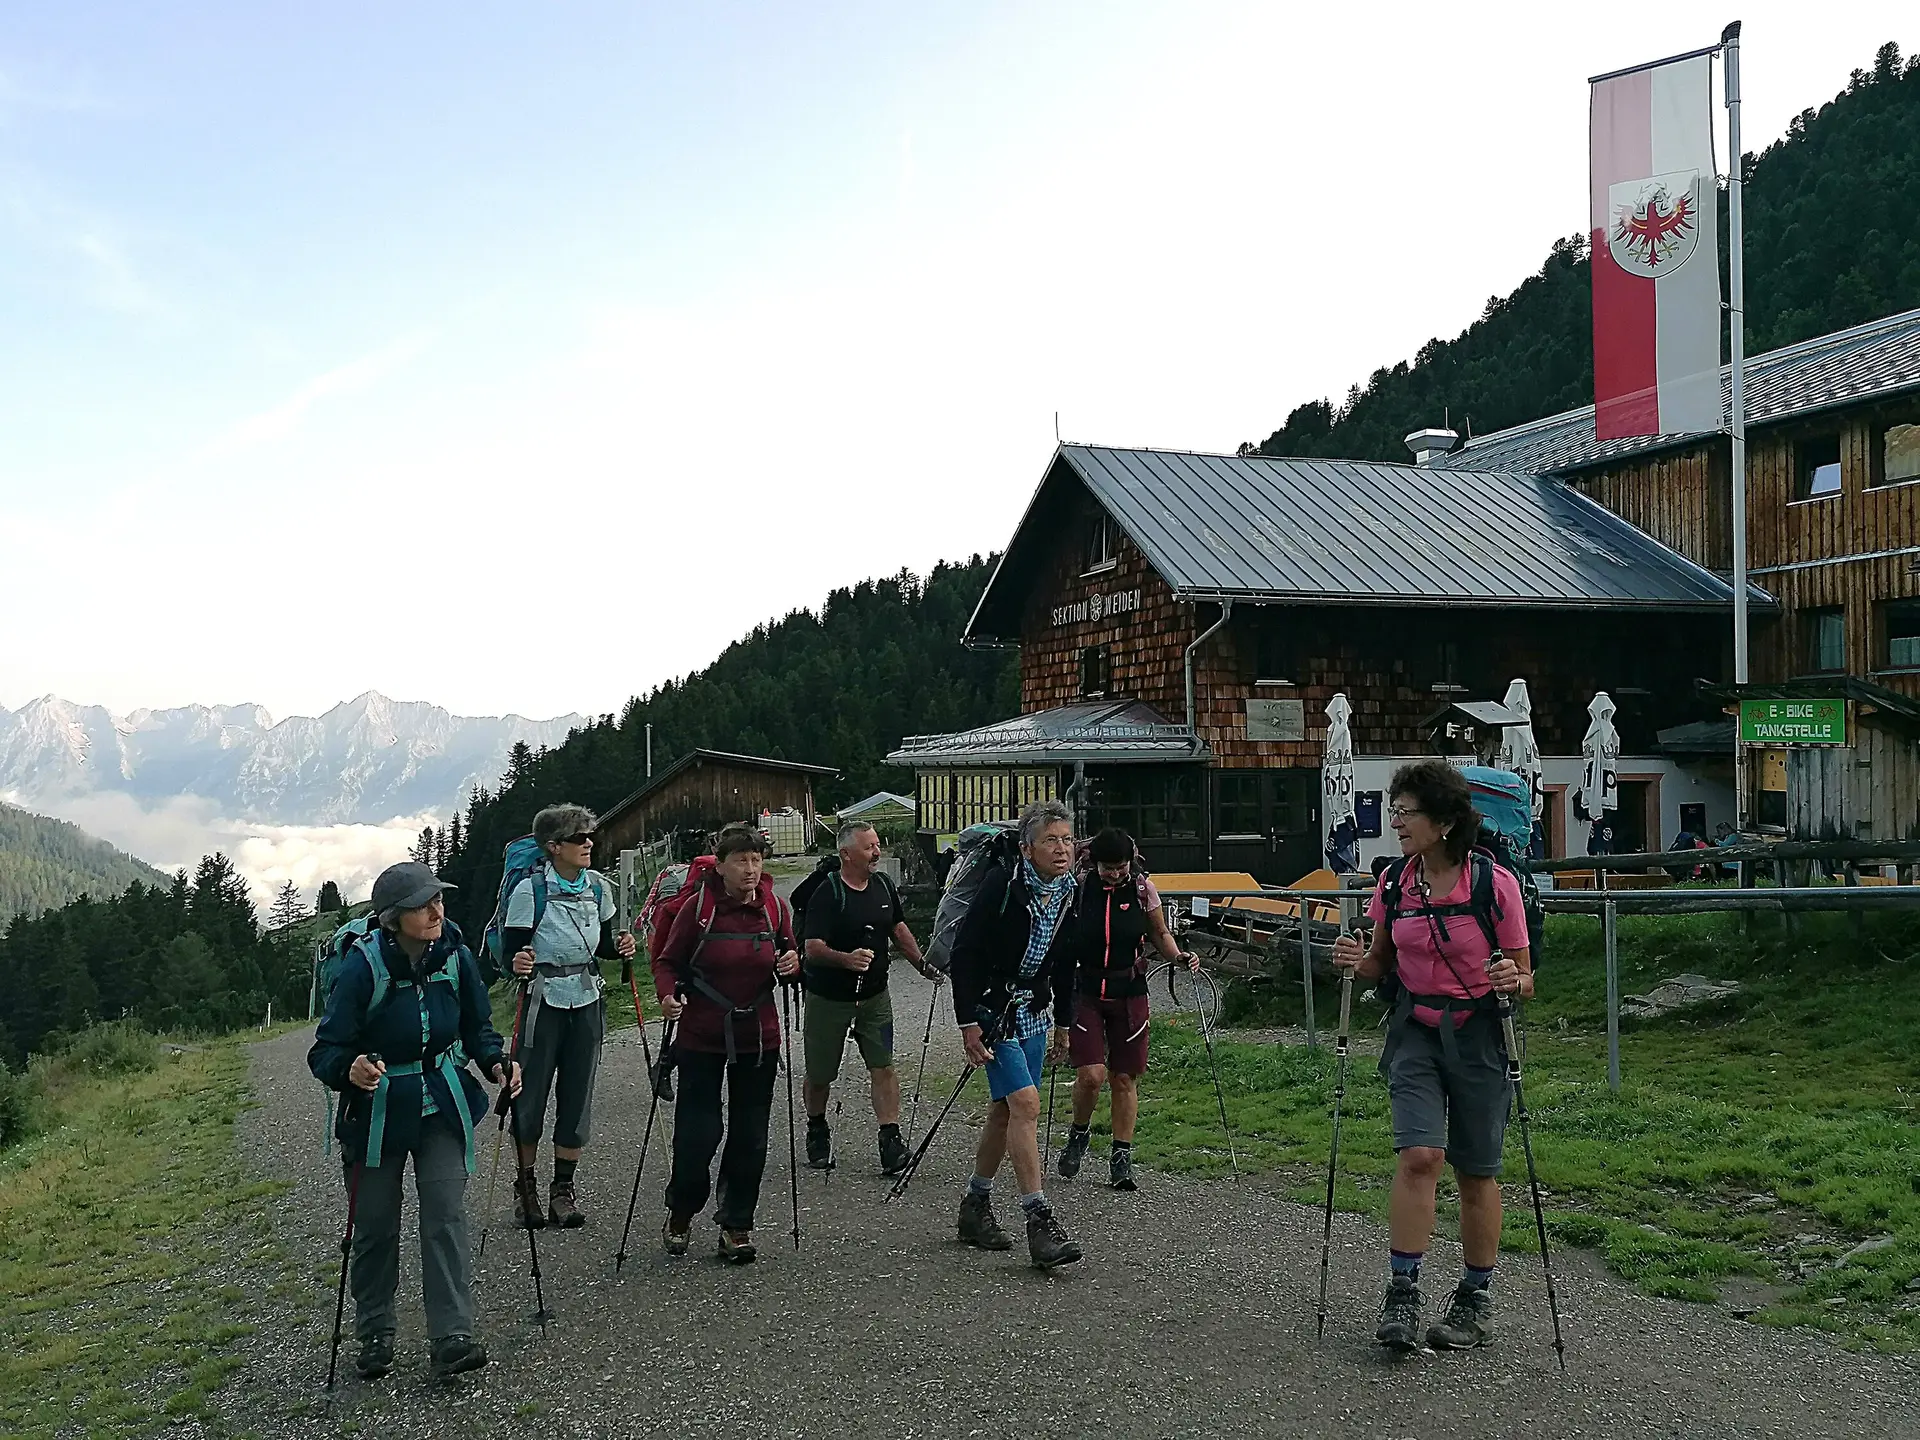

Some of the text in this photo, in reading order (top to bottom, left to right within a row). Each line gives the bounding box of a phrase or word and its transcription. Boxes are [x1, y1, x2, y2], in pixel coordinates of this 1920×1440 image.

[1052, 588, 1141, 626] SEKTION WEIDEN
[1754, 724, 1831, 738] TANKSTELLE
